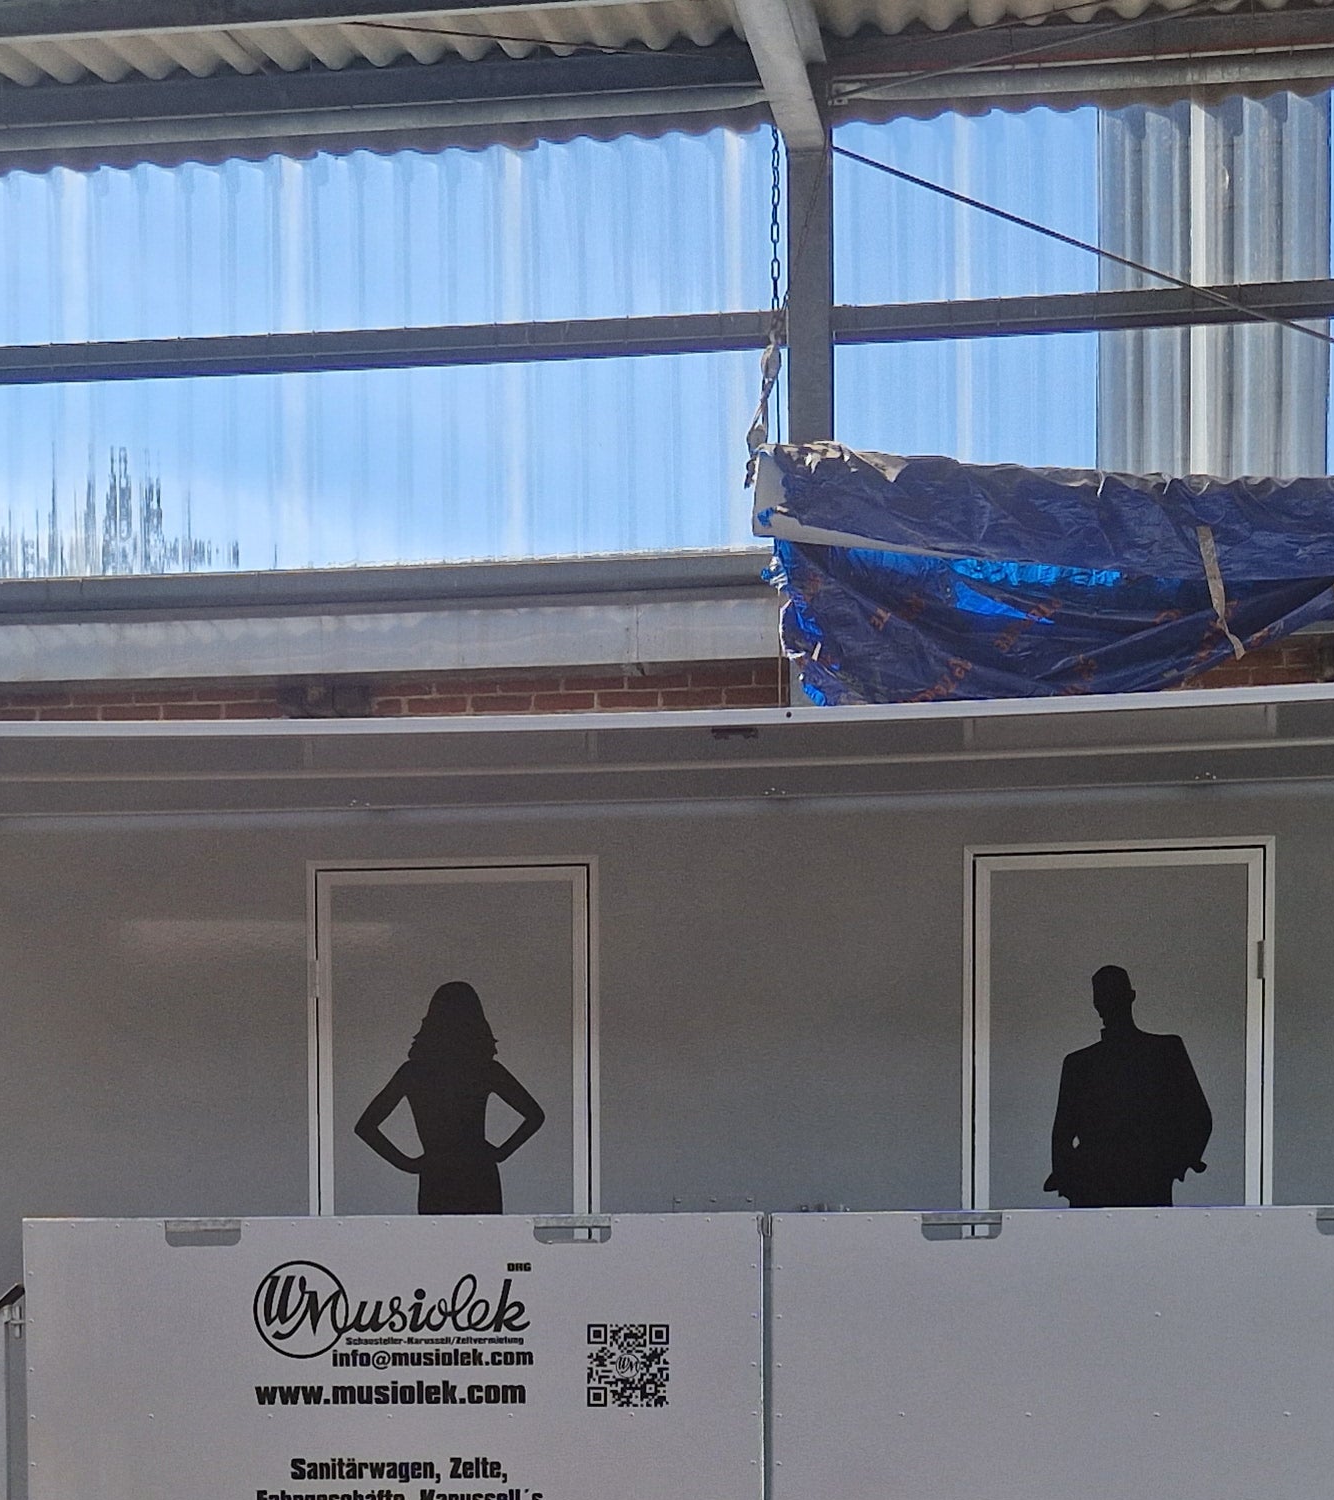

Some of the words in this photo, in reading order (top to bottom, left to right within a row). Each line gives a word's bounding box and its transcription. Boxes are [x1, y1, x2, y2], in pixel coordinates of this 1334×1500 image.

[331, 1348, 534, 1370] info@musiolek.com
[255, 1380, 527, 1405] www.musiolek.com
[290, 1457, 442, 1484] Sanitärwagen,
[449, 1457, 508, 1483] Zelte,
